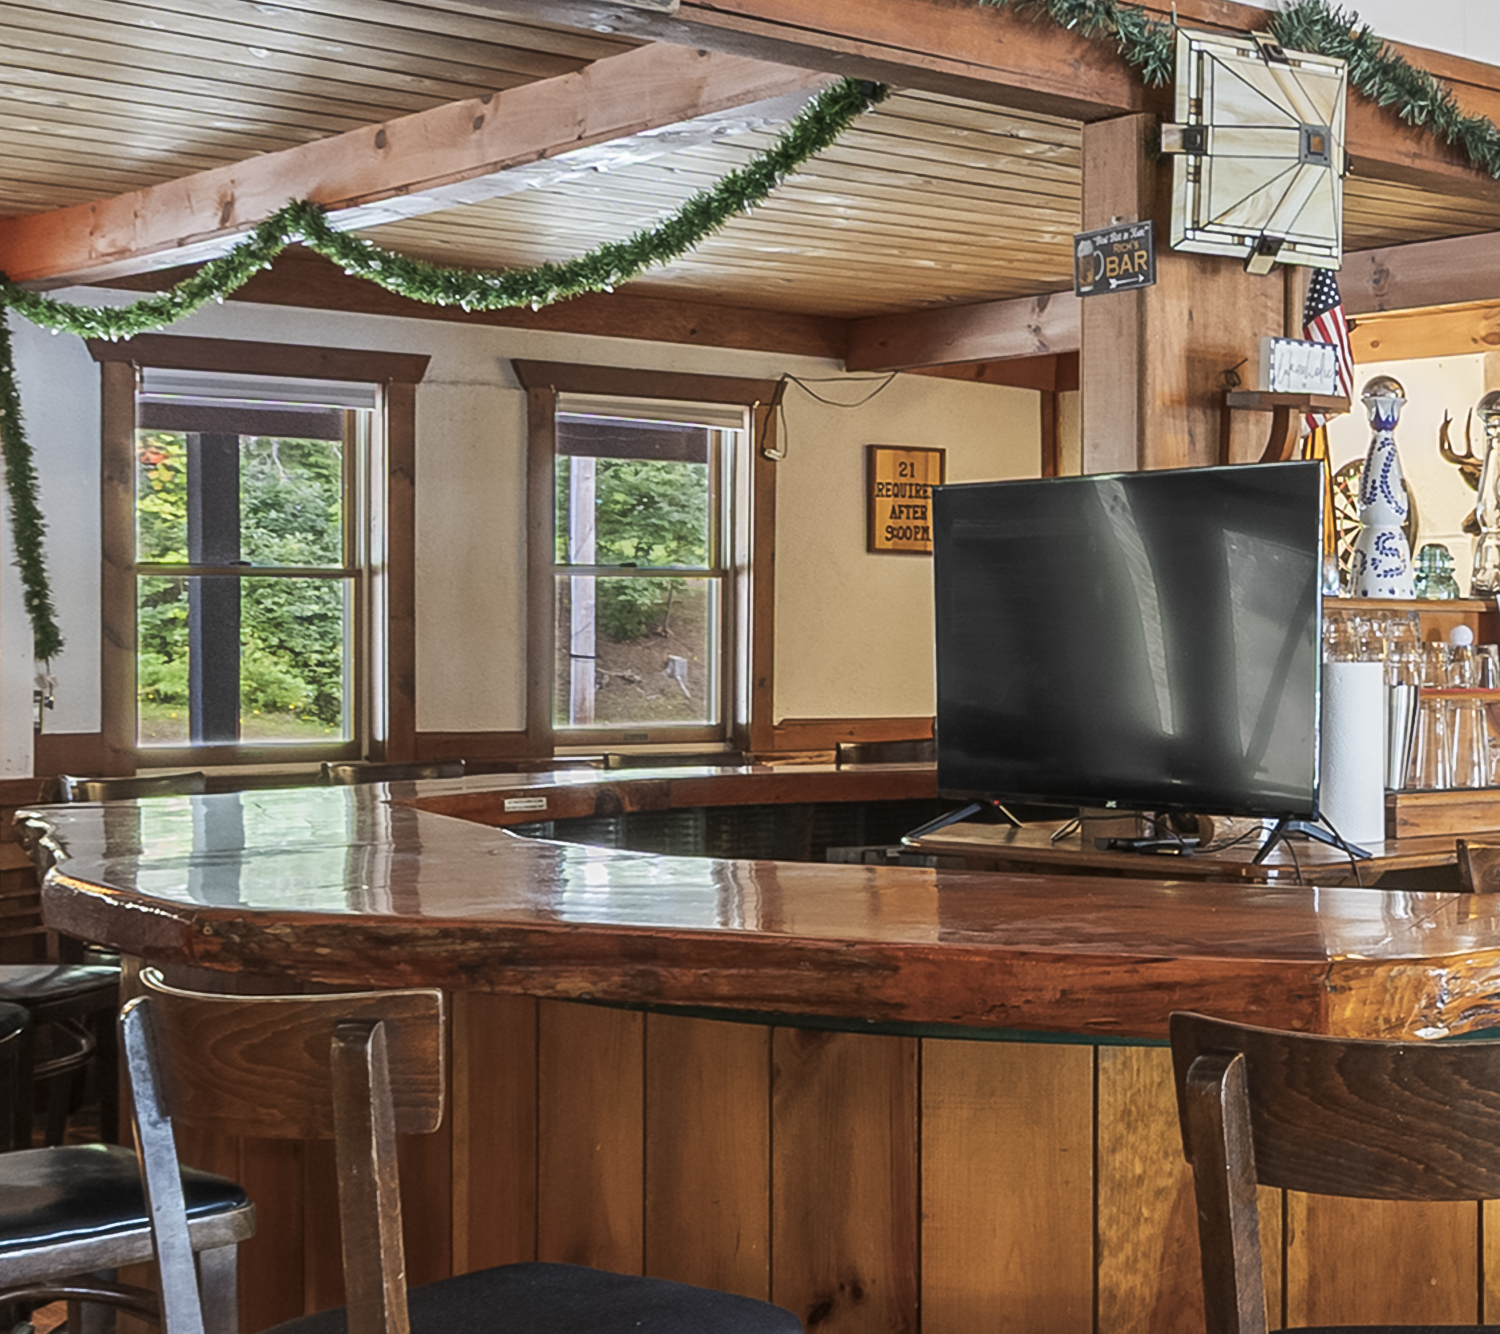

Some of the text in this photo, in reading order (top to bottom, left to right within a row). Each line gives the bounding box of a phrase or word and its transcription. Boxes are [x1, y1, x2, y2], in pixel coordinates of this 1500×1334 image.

[1106, 250, 1148, 277] BAR
[898, 461, 915, 478] 21
[875, 482, 932, 499] REQUIRE
[889, 504, 928, 521] AFTER
